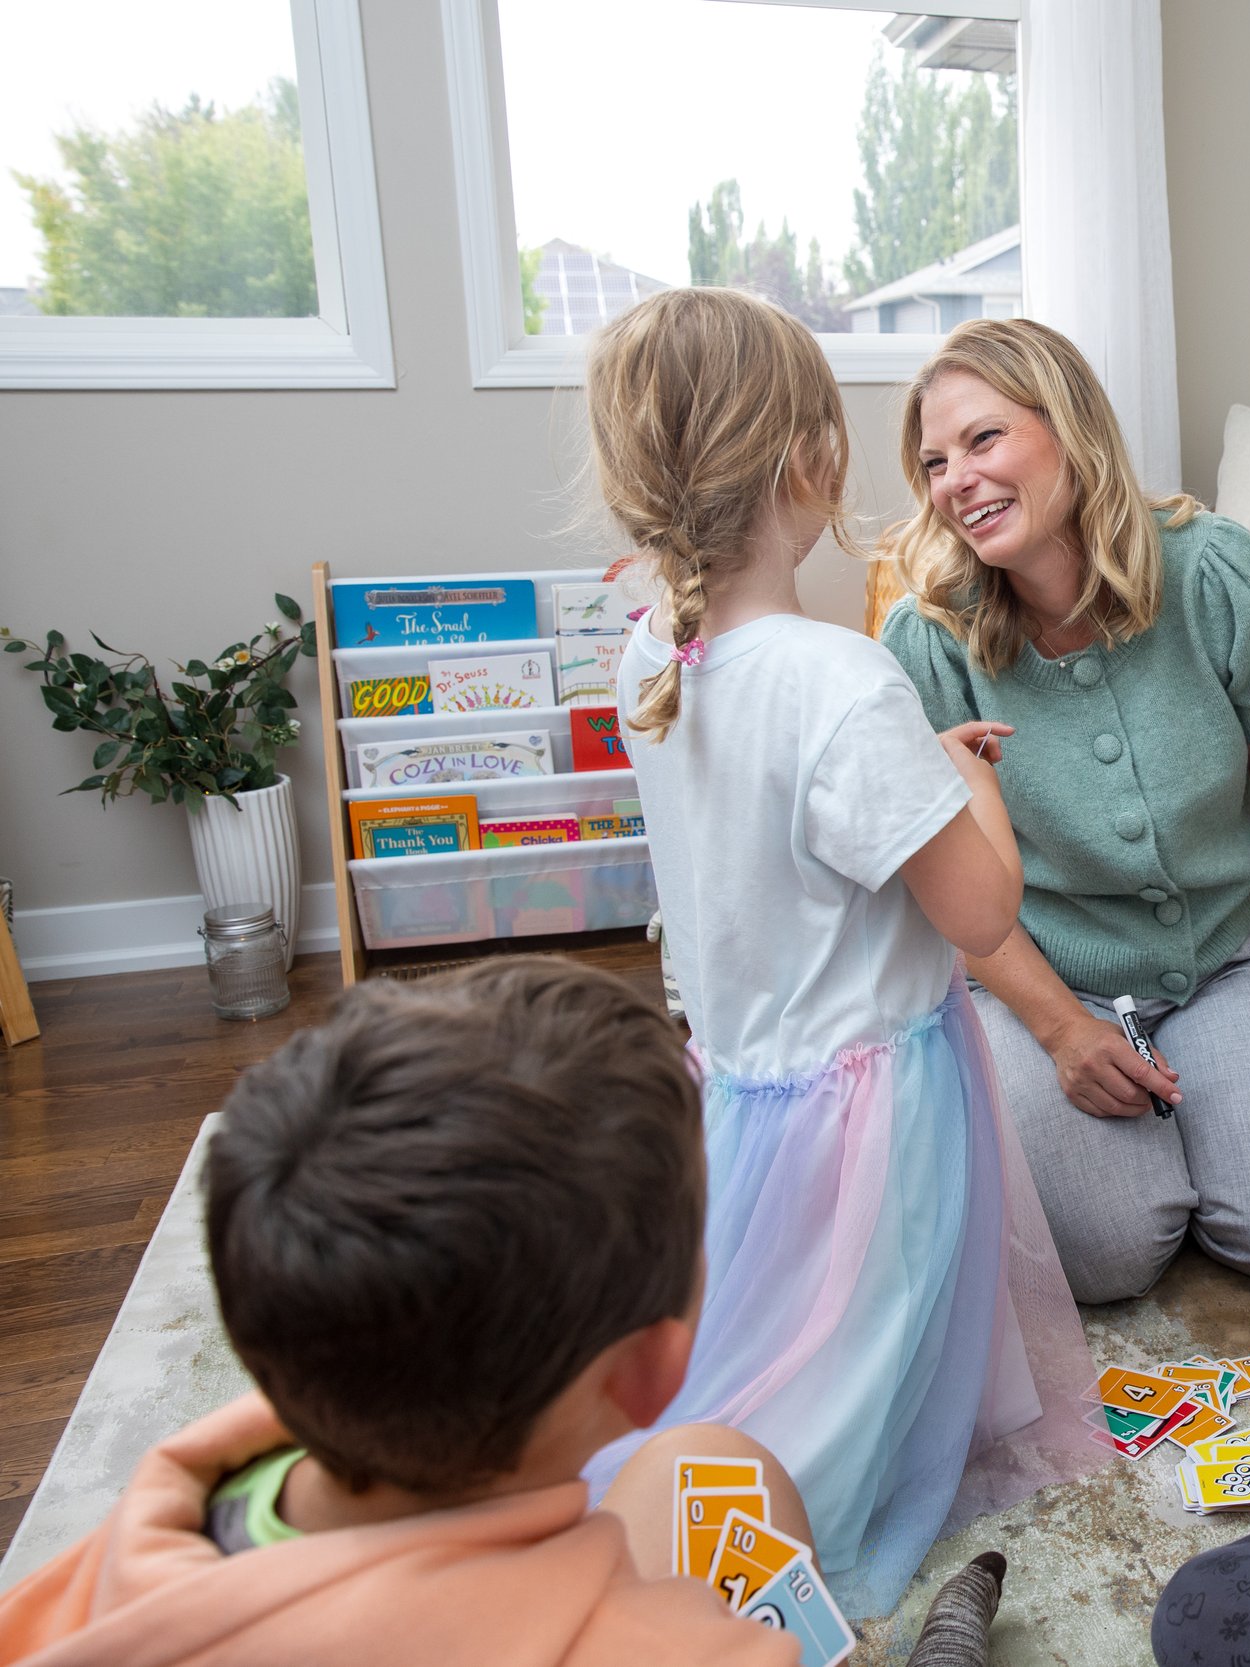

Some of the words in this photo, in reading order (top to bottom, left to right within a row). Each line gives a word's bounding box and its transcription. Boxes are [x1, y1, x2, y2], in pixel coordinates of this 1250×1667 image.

[396, 612, 429, 635] The
[431, 611, 471, 634] Snail
[595, 646, 615, 656] The
[600, 658, 612, 671] of
[436, 681, 456, 693] Dr.
[454, 668, 488, 683] Seuss
[354, 680, 433, 710] GOOD
[428, 745, 445, 755] JAN
[449, 743, 482, 753] BRETT
[389, 757, 446, 785] COZY
[452, 757, 466, 768] IN
[471, 754, 524, 775] LOVE
[405, 828, 424, 836] The
[588, 819, 614, 831] THE
[377, 836, 425, 849] Thank
[428, 835, 453, 846] You
[520, 835, 563, 846] Chicka
[1122, 1384, 1156, 1402] 4
[1173, 1385, 1185, 1393] 4
[1214, 1416, 1227, 1426] 5
[682, 1467, 693, 1489] 1
[690, 1500, 705, 1524] 0
[732, 1525, 756, 1554] 10
